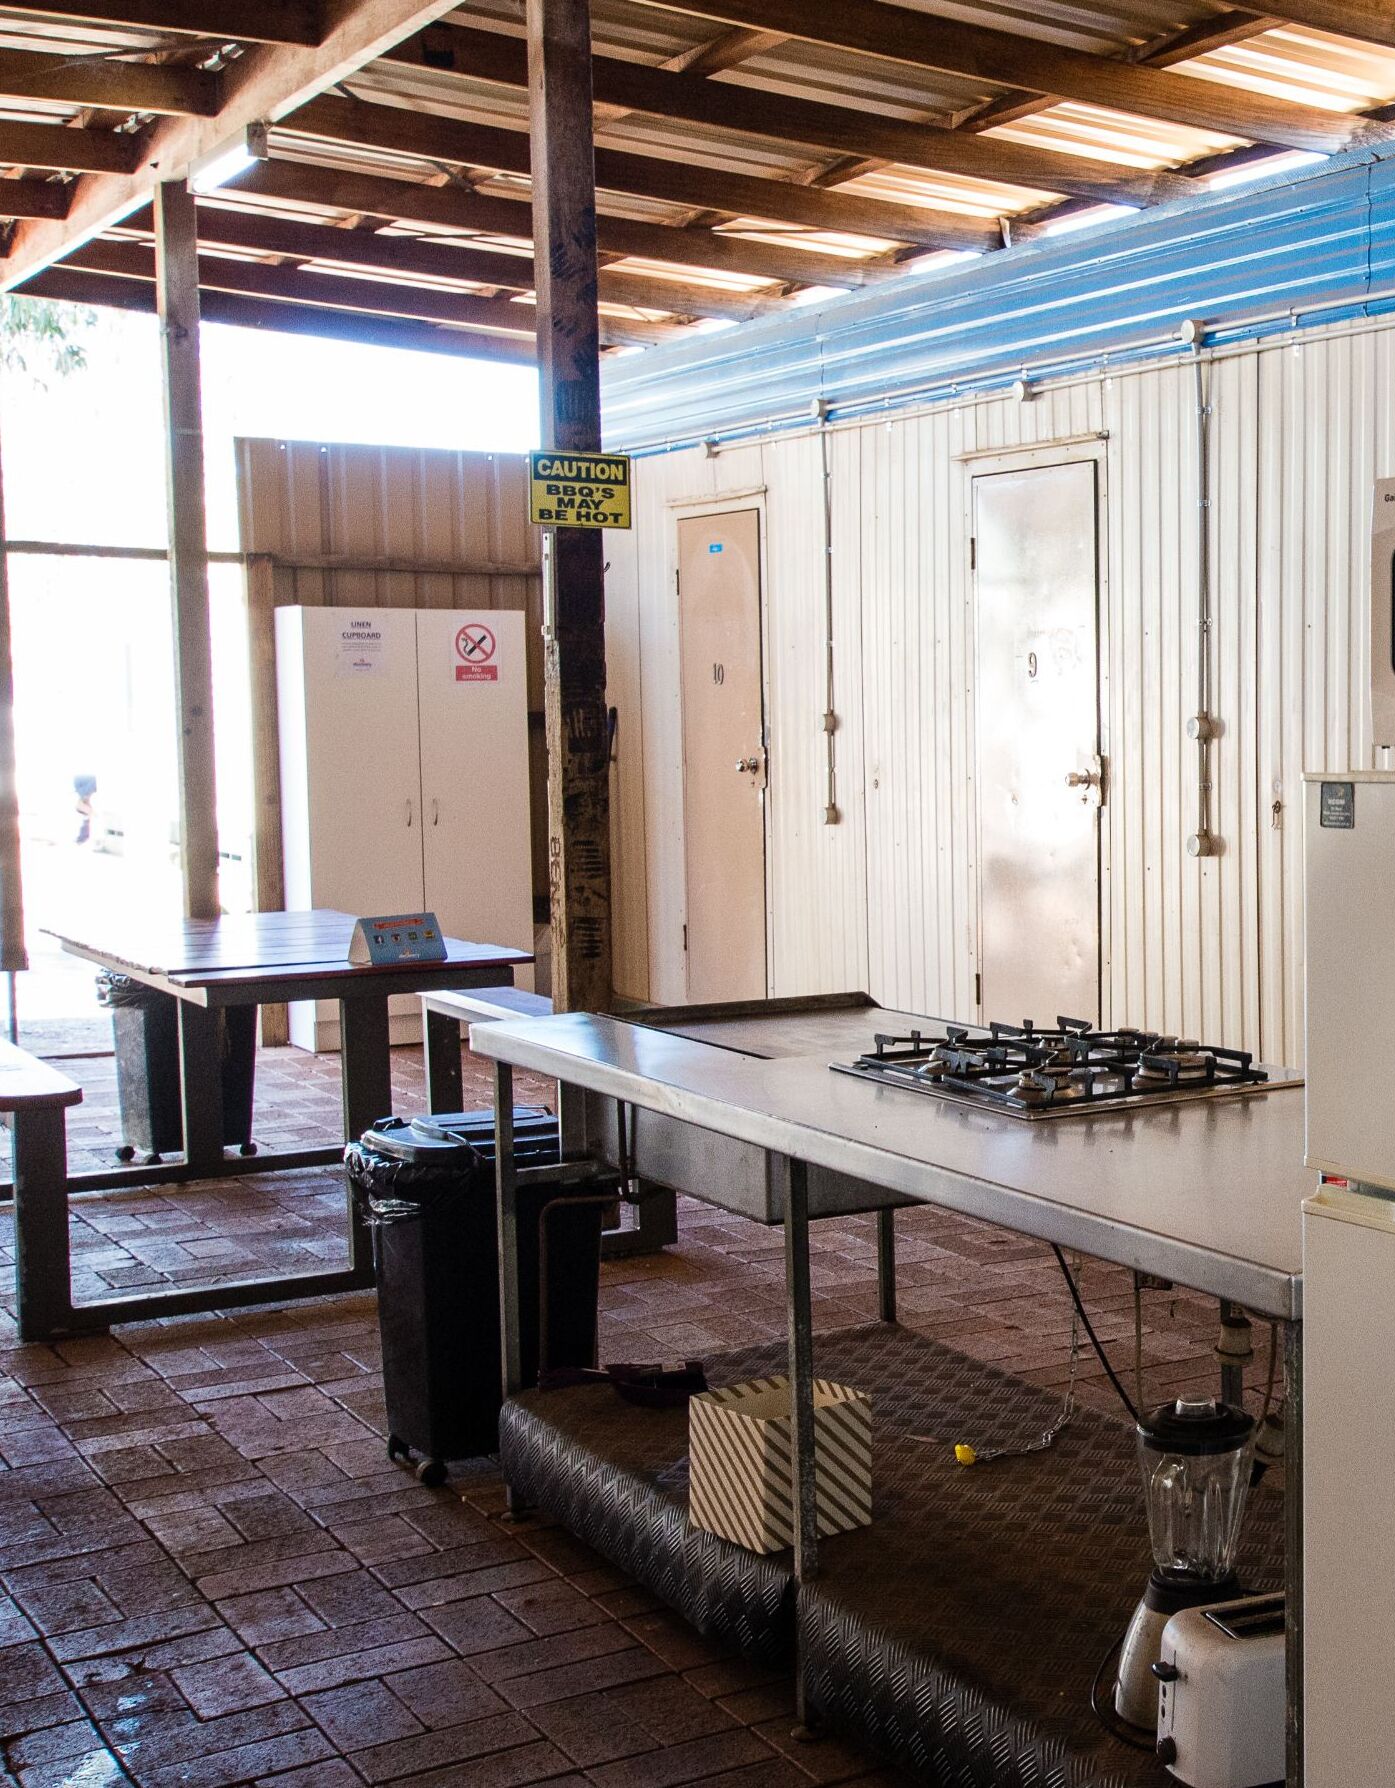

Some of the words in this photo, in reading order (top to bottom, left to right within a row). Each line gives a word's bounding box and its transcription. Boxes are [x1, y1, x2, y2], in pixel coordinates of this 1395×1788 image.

[537, 459, 624, 480] CAUTION
[546, 484, 615, 499] BBQ'S
[557, 497, 604, 510] MAY
[538, 508, 569, 521] BE
[576, 511, 623, 524] HOT
[342, 632, 381, 640] CUPBOARD
[1028, 651, 1038, 679] 9
